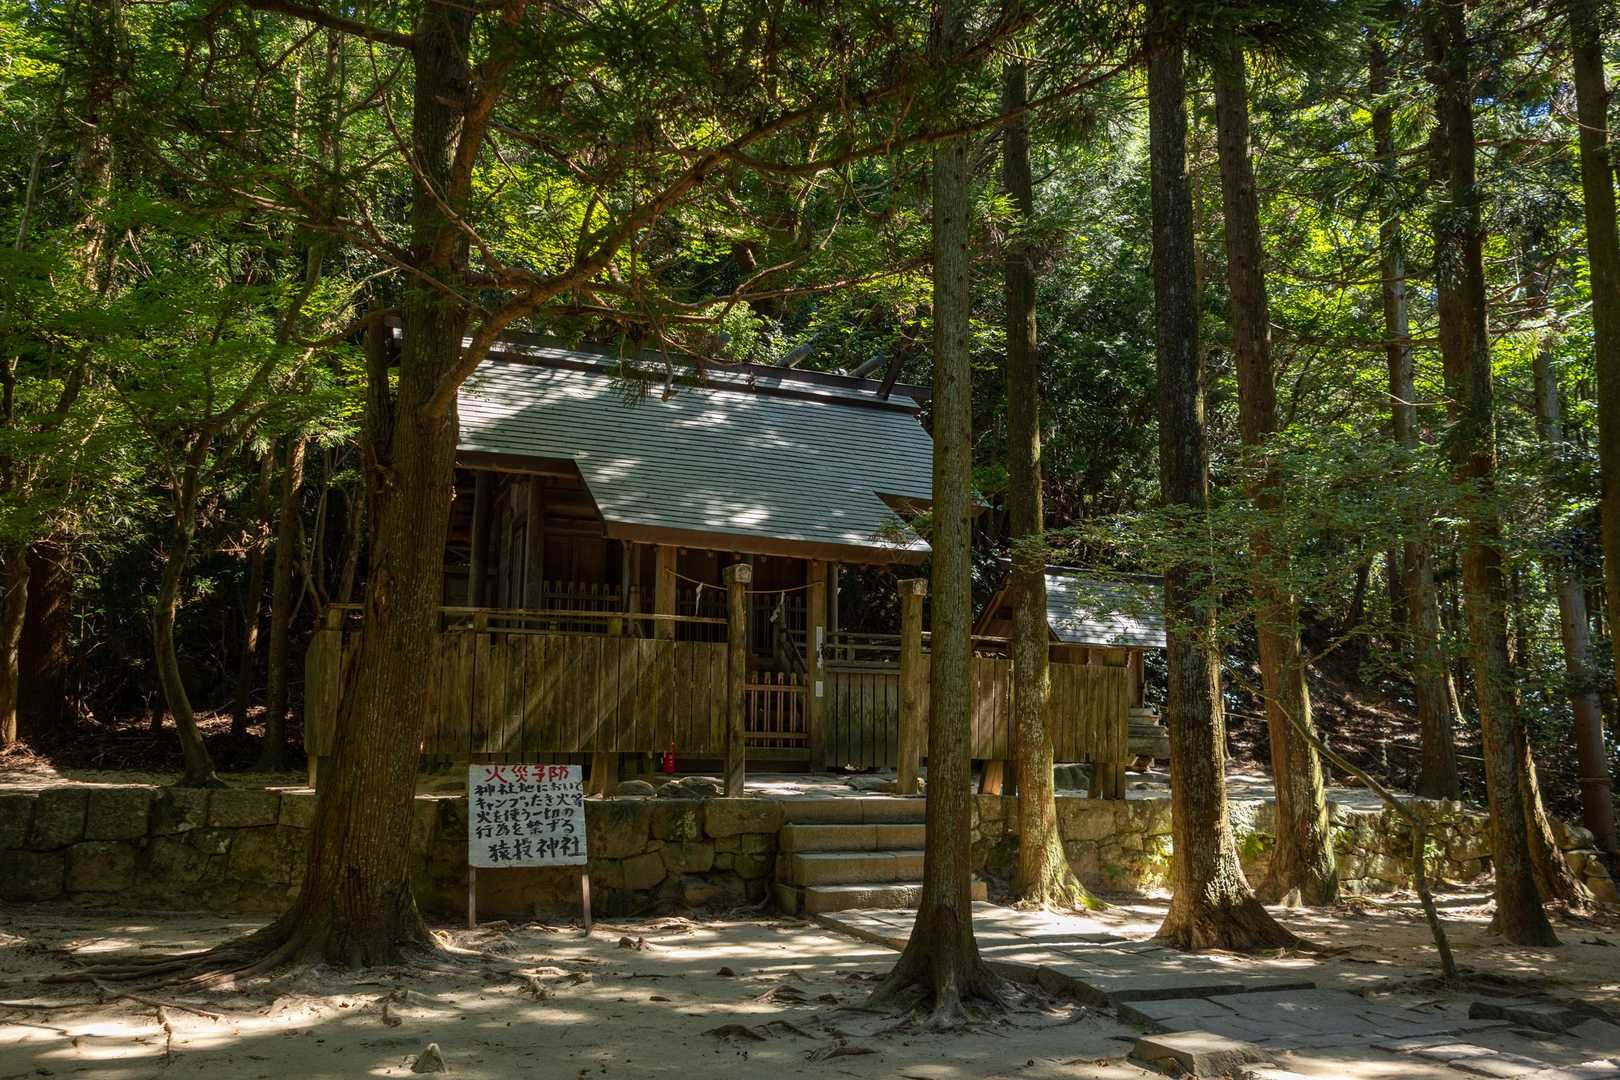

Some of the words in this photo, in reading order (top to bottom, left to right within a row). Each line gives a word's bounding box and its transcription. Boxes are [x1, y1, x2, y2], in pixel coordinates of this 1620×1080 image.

[485, 765, 569, 784] 火災予防
[476, 808, 574, 823] 火を使う一切の
[476, 818, 574, 839] 行為を禁ずる
[488, 836, 585, 862] 猿投神社
